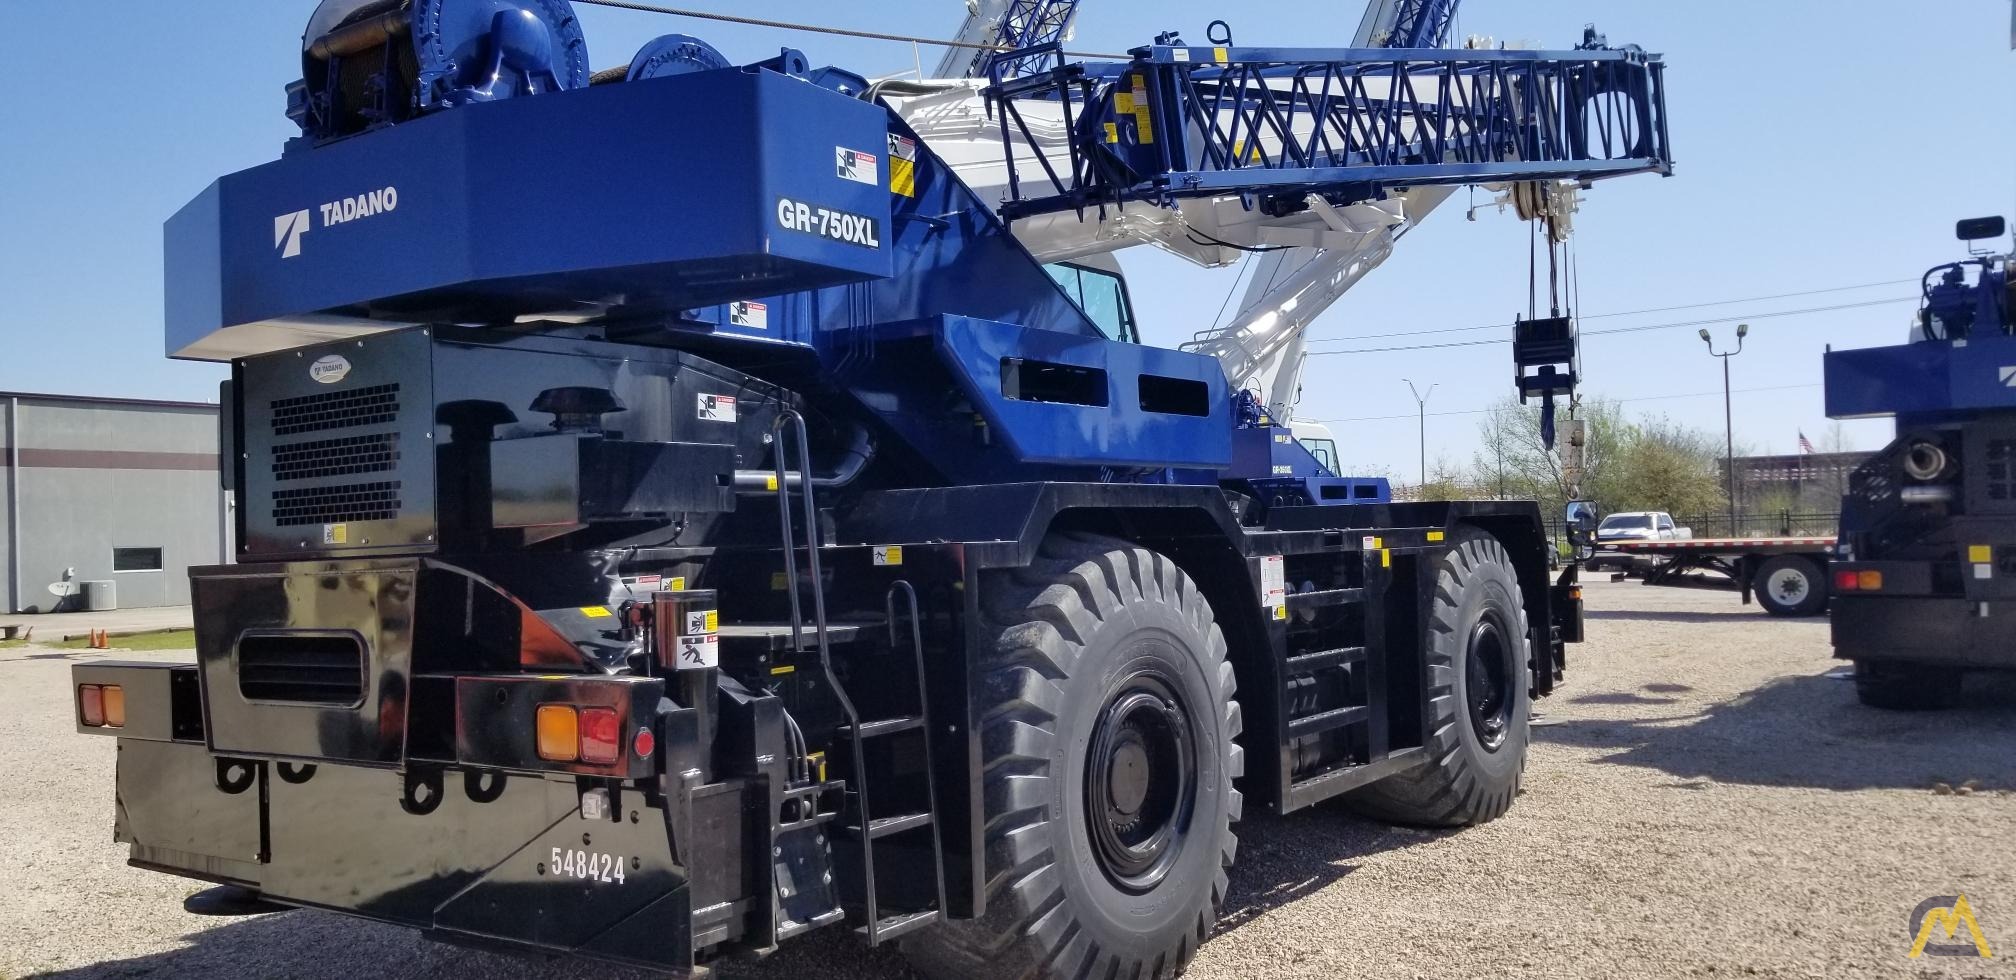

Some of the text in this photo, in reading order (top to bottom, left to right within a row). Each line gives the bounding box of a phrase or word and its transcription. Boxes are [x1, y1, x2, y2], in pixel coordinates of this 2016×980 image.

[320, 186, 397, 227] TADANO
[778, 199, 879, 247] GR-750XL
[321, 363, 343, 373] TADANO
[552, 847, 625, 885] 548424
